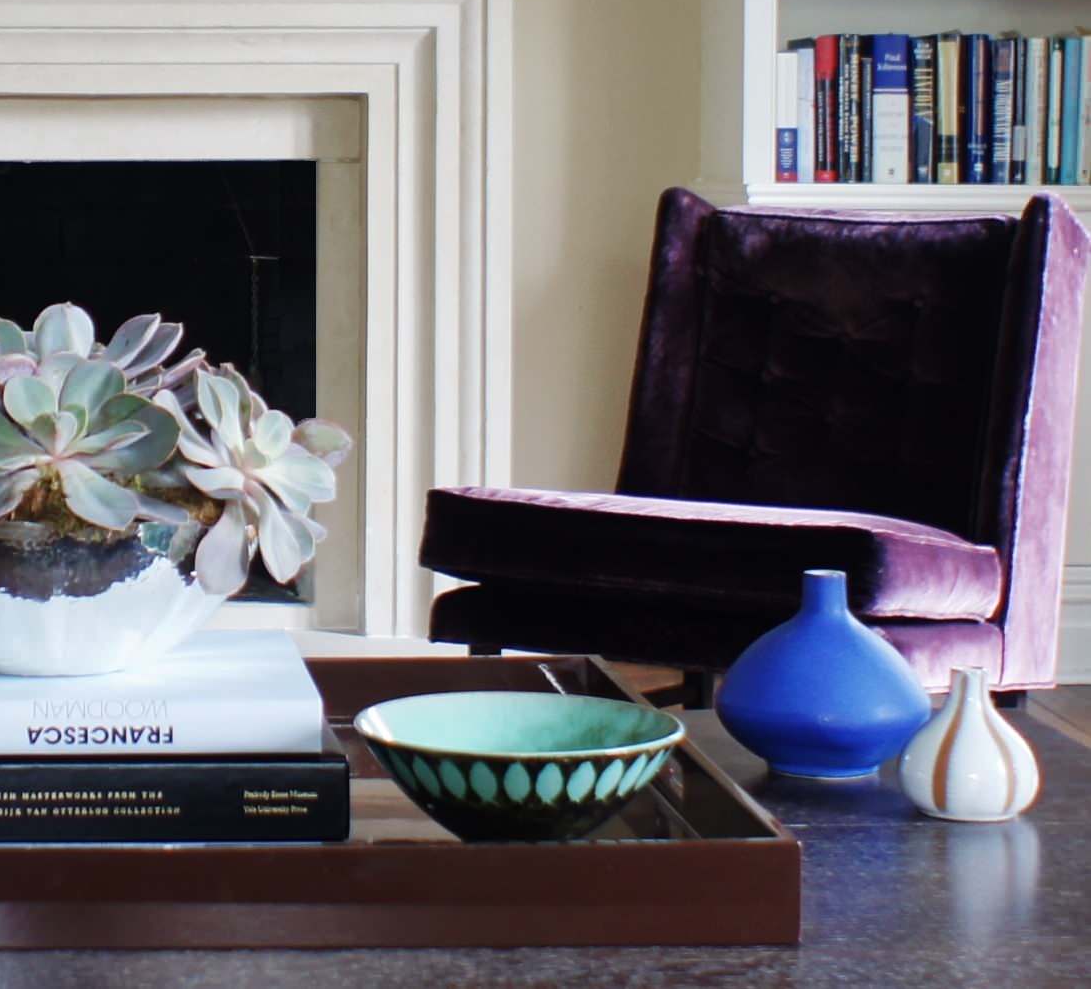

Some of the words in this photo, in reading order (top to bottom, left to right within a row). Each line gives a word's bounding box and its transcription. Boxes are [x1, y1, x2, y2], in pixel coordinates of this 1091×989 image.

[850, 115, 860, 163] POWER
[31, 699, 169, 720] WOODMAN
[27, 725, 174, 745] FRANCESCA
